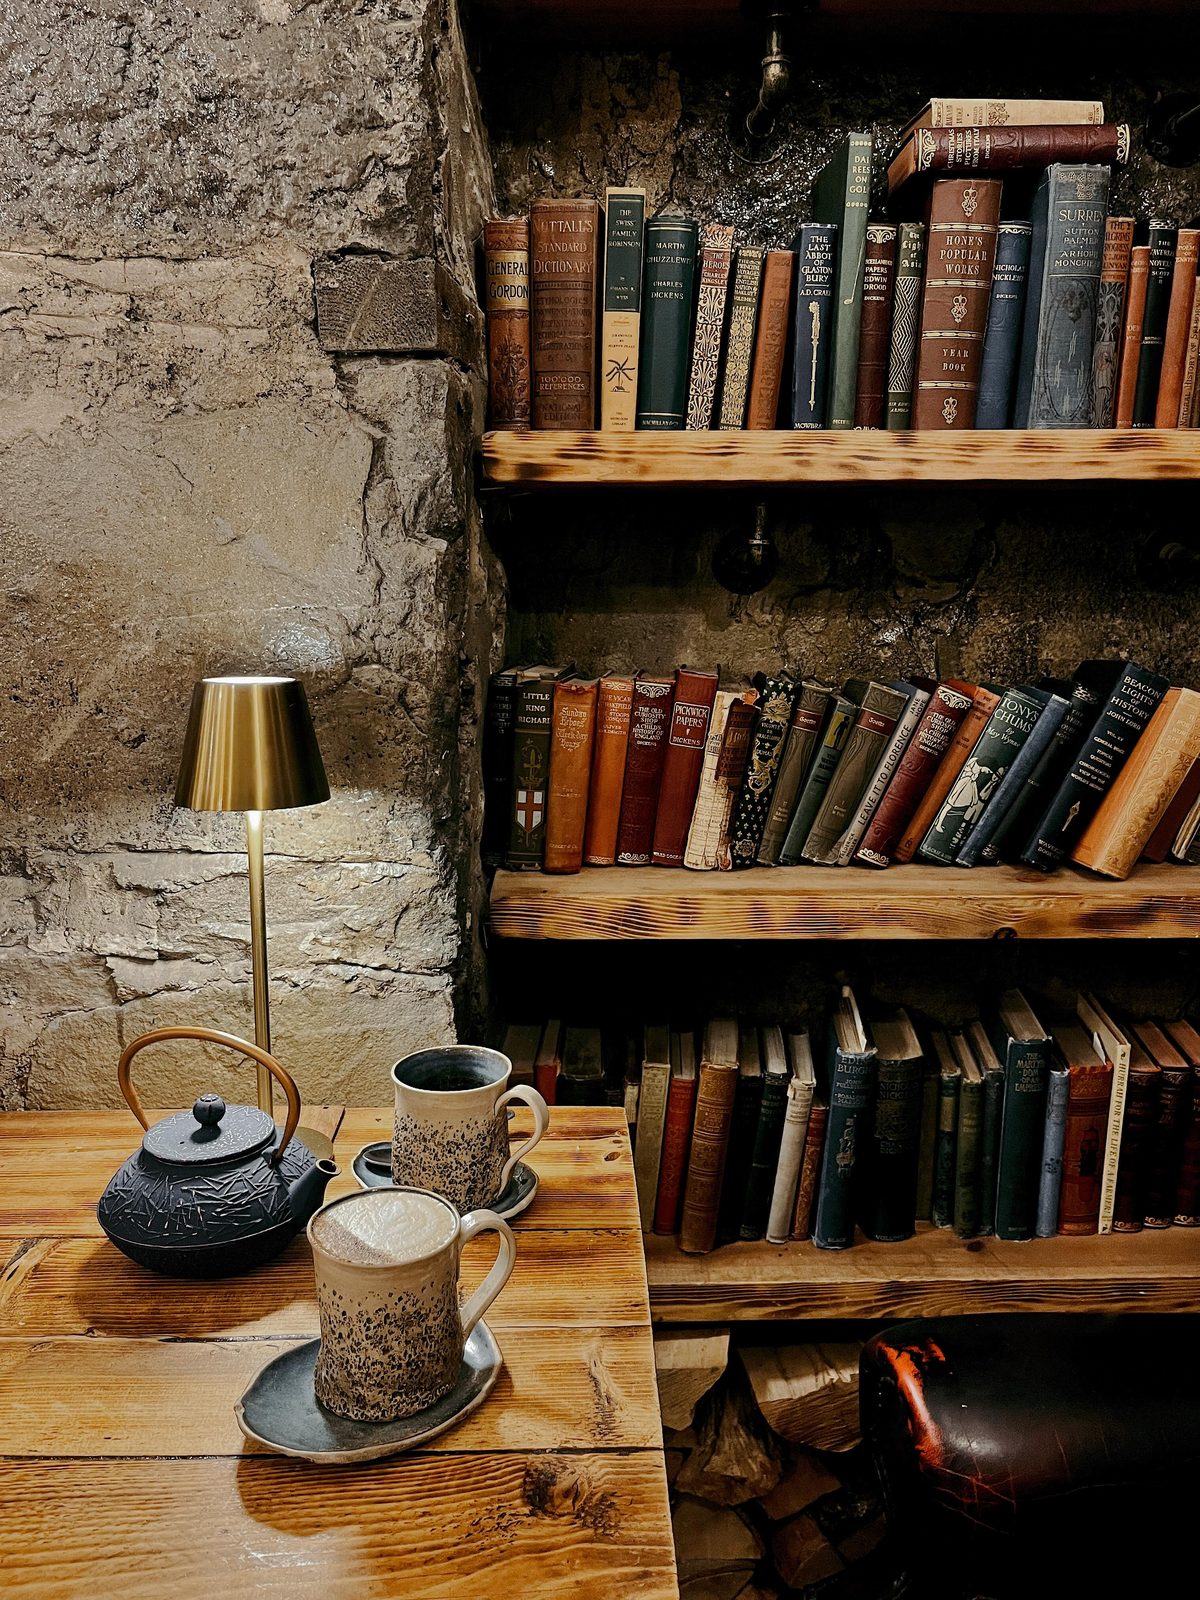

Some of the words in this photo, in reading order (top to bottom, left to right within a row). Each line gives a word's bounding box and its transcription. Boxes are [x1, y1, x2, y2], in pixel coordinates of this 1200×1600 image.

[972, 127, 980, 147] ITALY
[947, 128, 955, 169] CHRISTMAS
[955, 132, 963, 163] STORIES
[964, 129, 972, 166] PICTURES
[854, 155, 870, 164] DAI
[852, 165, 871, 175] REES
[855, 175, 868, 184] ON
[849, 185, 868, 194] GOL
[618, 208, 633, 217] THE
[1058, 208, 1104, 222] SURREY
[615, 219, 635, 228] SWISS
[611, 229, 638, 239] FAMILY
[1064, 227, 1100, 236] SUTTON
[1104, 231, 1132, 242] ILGRIMS
[608, 239, 642, 248] ROBINSON
[810, 235, 829, 244] THE
[946, 235, 984, 246] HONE'S
[538, 242, 588, 253] STANDARD
[656, 241, 686, 250] MARTIN
[807, 243, 832, 252] LAST
[712, 252, 723, 260] THE
[805, 251, 833, 261] ABBOT
[939, 249, 988, 261] POPULAR
[487, 260, 529, 277] GENERAL
[533, 259, 593, 274] DICTIONARY
[703, 260, 731, 270] HEROES
[1054, 259, 1099, 268] MONCRIE
[801, 265, 833, 275] GLASTON
[865, 266, 888, 275] PAPERS
[945, 263, 980, 275] WORKS
[806, 274, 829, 283] BURY
[864, 275, 888, 284] EDWIN
[653, 280, 684, 289] CHARLES
[864, 284, 888, 293] DROOD
[489, 281, 529, 301] GORDON
[651, 291, 684, 300] DICKENS
[1190, 297, 1200, 339] SELBORN
[942, 348, 969, 358] YEAR
[942, 361, 967, 372] BOOK
[1183, 355, 1196, 390] HISTORY
[538, 383, 586, 391] REFERENCES
[1179, 391, 1191, 427] NATURAL
[1123, 675, 1162, 700] BEACON
[522, 692, 551, 701] LITTLE
[1120, 685, 1154, 706] LIGHTS
[910, 698, 921, 715] JANE
[1130, 697, 1140, 706] OF
[525, 704, 547, 713] KING
[674, 704, 708, 719] PICKWICK
[915, 700, 926, 719] HOPE
[1000, 696, 1040, 722] TONY'S
[1110, 696, 1150, 720] HISTORY
[633, 711, 667, 720] CURIOSITY
[640, 716, 659, 724] SHOP
[994, 708, 1033, 733] CHUMS
[1106, 710, 1125, 723] JOHN
[1125, 718, 1141, 731] LORD
[675, 716, 704, 728] PAPERS
[634, 732, 661, 741] ENGLAND
[985, 726, 1001, 739] May
[672, 736, 701, 746] DICKENS
[858, 796, 877, 826] LEAVE
[873, 784, 883, 795] IT
[878, 773, 888, 784] TO
[885, 725, 911, 772] FLORENCE
[1022, 1068, 1040, 1077] DOM
[1116, 1062, 1127, 1099] HURRAH
[1114, 1100, 1122, 1117] FOR
[1112, 1119, 1120, 1136] THE
[1109, 1139, 1118, 1157] LIFE
[1108, 1159, 1116, 1169] OF
